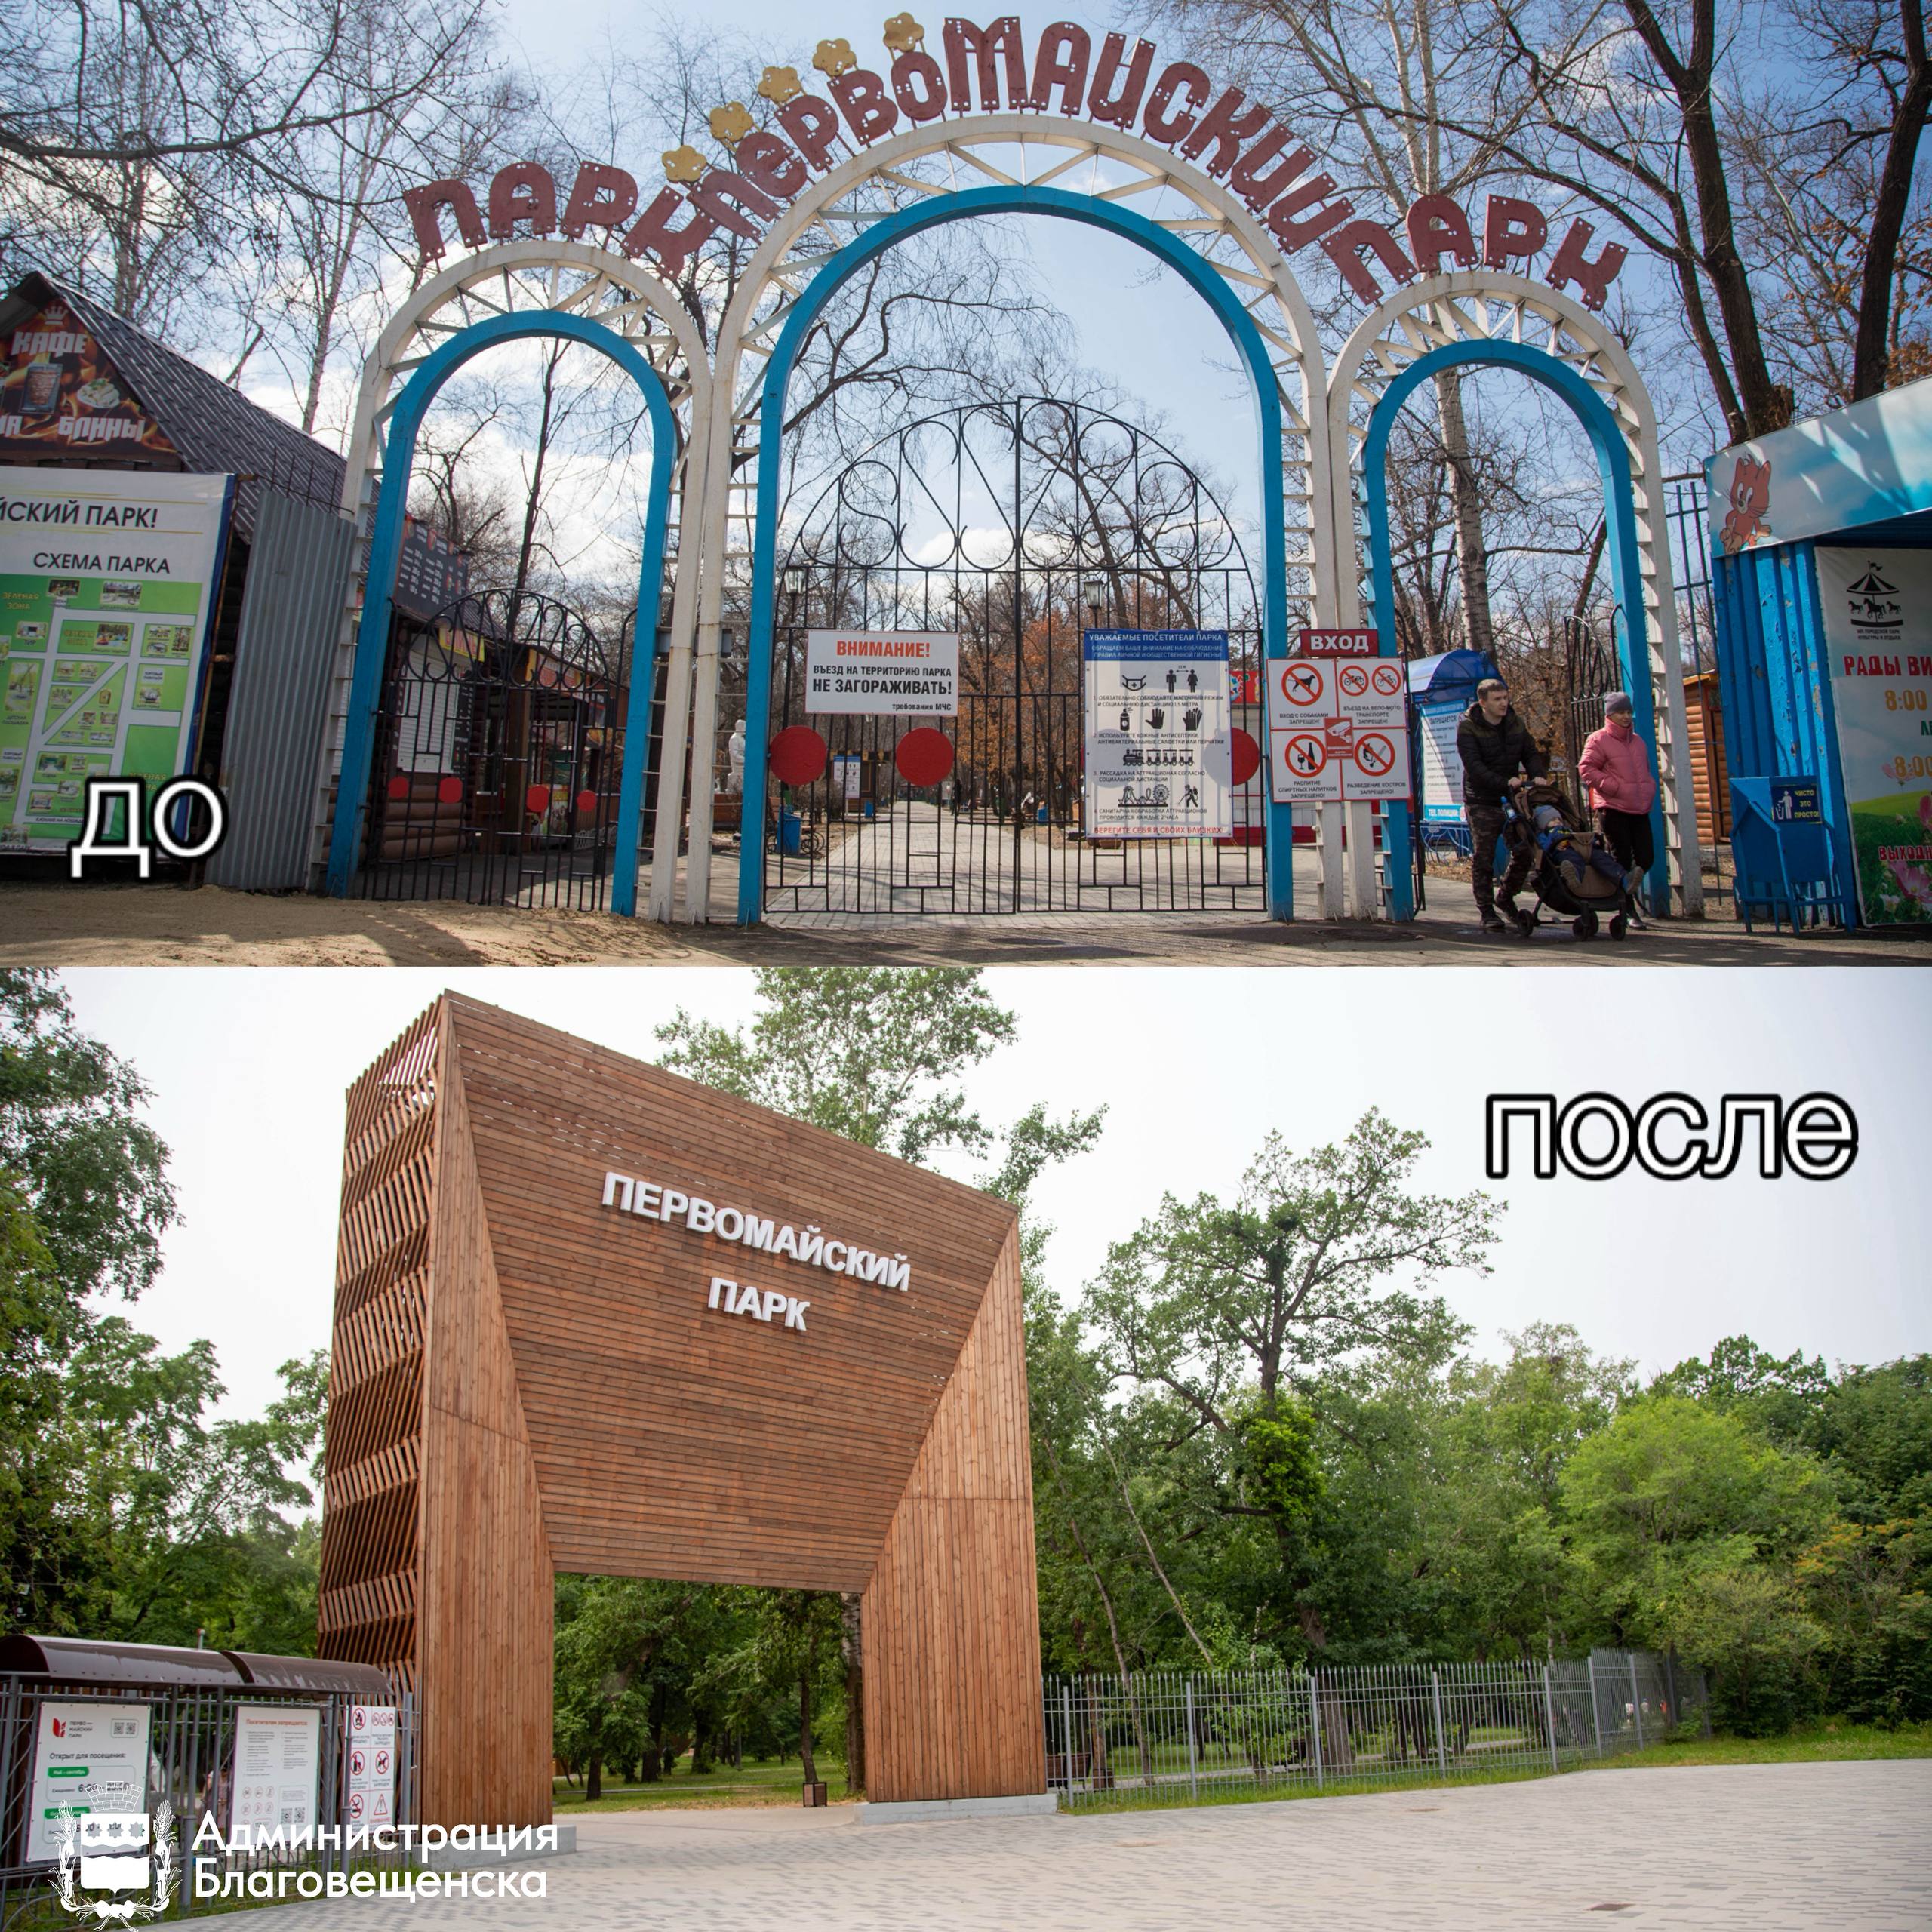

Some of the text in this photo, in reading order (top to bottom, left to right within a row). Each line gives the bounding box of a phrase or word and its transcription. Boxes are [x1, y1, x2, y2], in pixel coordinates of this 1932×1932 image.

[402, 160, 721, 282] ПАРК
[1320, 193, 1629, 312] ПАРК
[11, 331, 88, 358] КАФЕ
[85, 505, 158, 528] ПАРК!
[33, 552, 171, 574] СХЕМА ПАРКА
[836, 640, 931, 658] ВНИМАНИЕ!
[1310, 635, 1370, 652] ВХОД
[813, 665, 952, 677] ВЪЕЗД НА ТЕРРИТОРИЮ ПАРКА
[1844, 655, 1903, 676] РАДЫ
[812, 679, 952, 695] НЕ ЗАГОРАЖИВАТЬ!
[891, 703, 952, 711] требования МЧС
[1884, 689, 1927, 711] 8:00
[602, 1171, 911, 1291] ПЕРВОМАЙСКИЙ
[708, 1277, 811, 1331] ПАРК
[49, 1752, 75, 1761] Открыт
